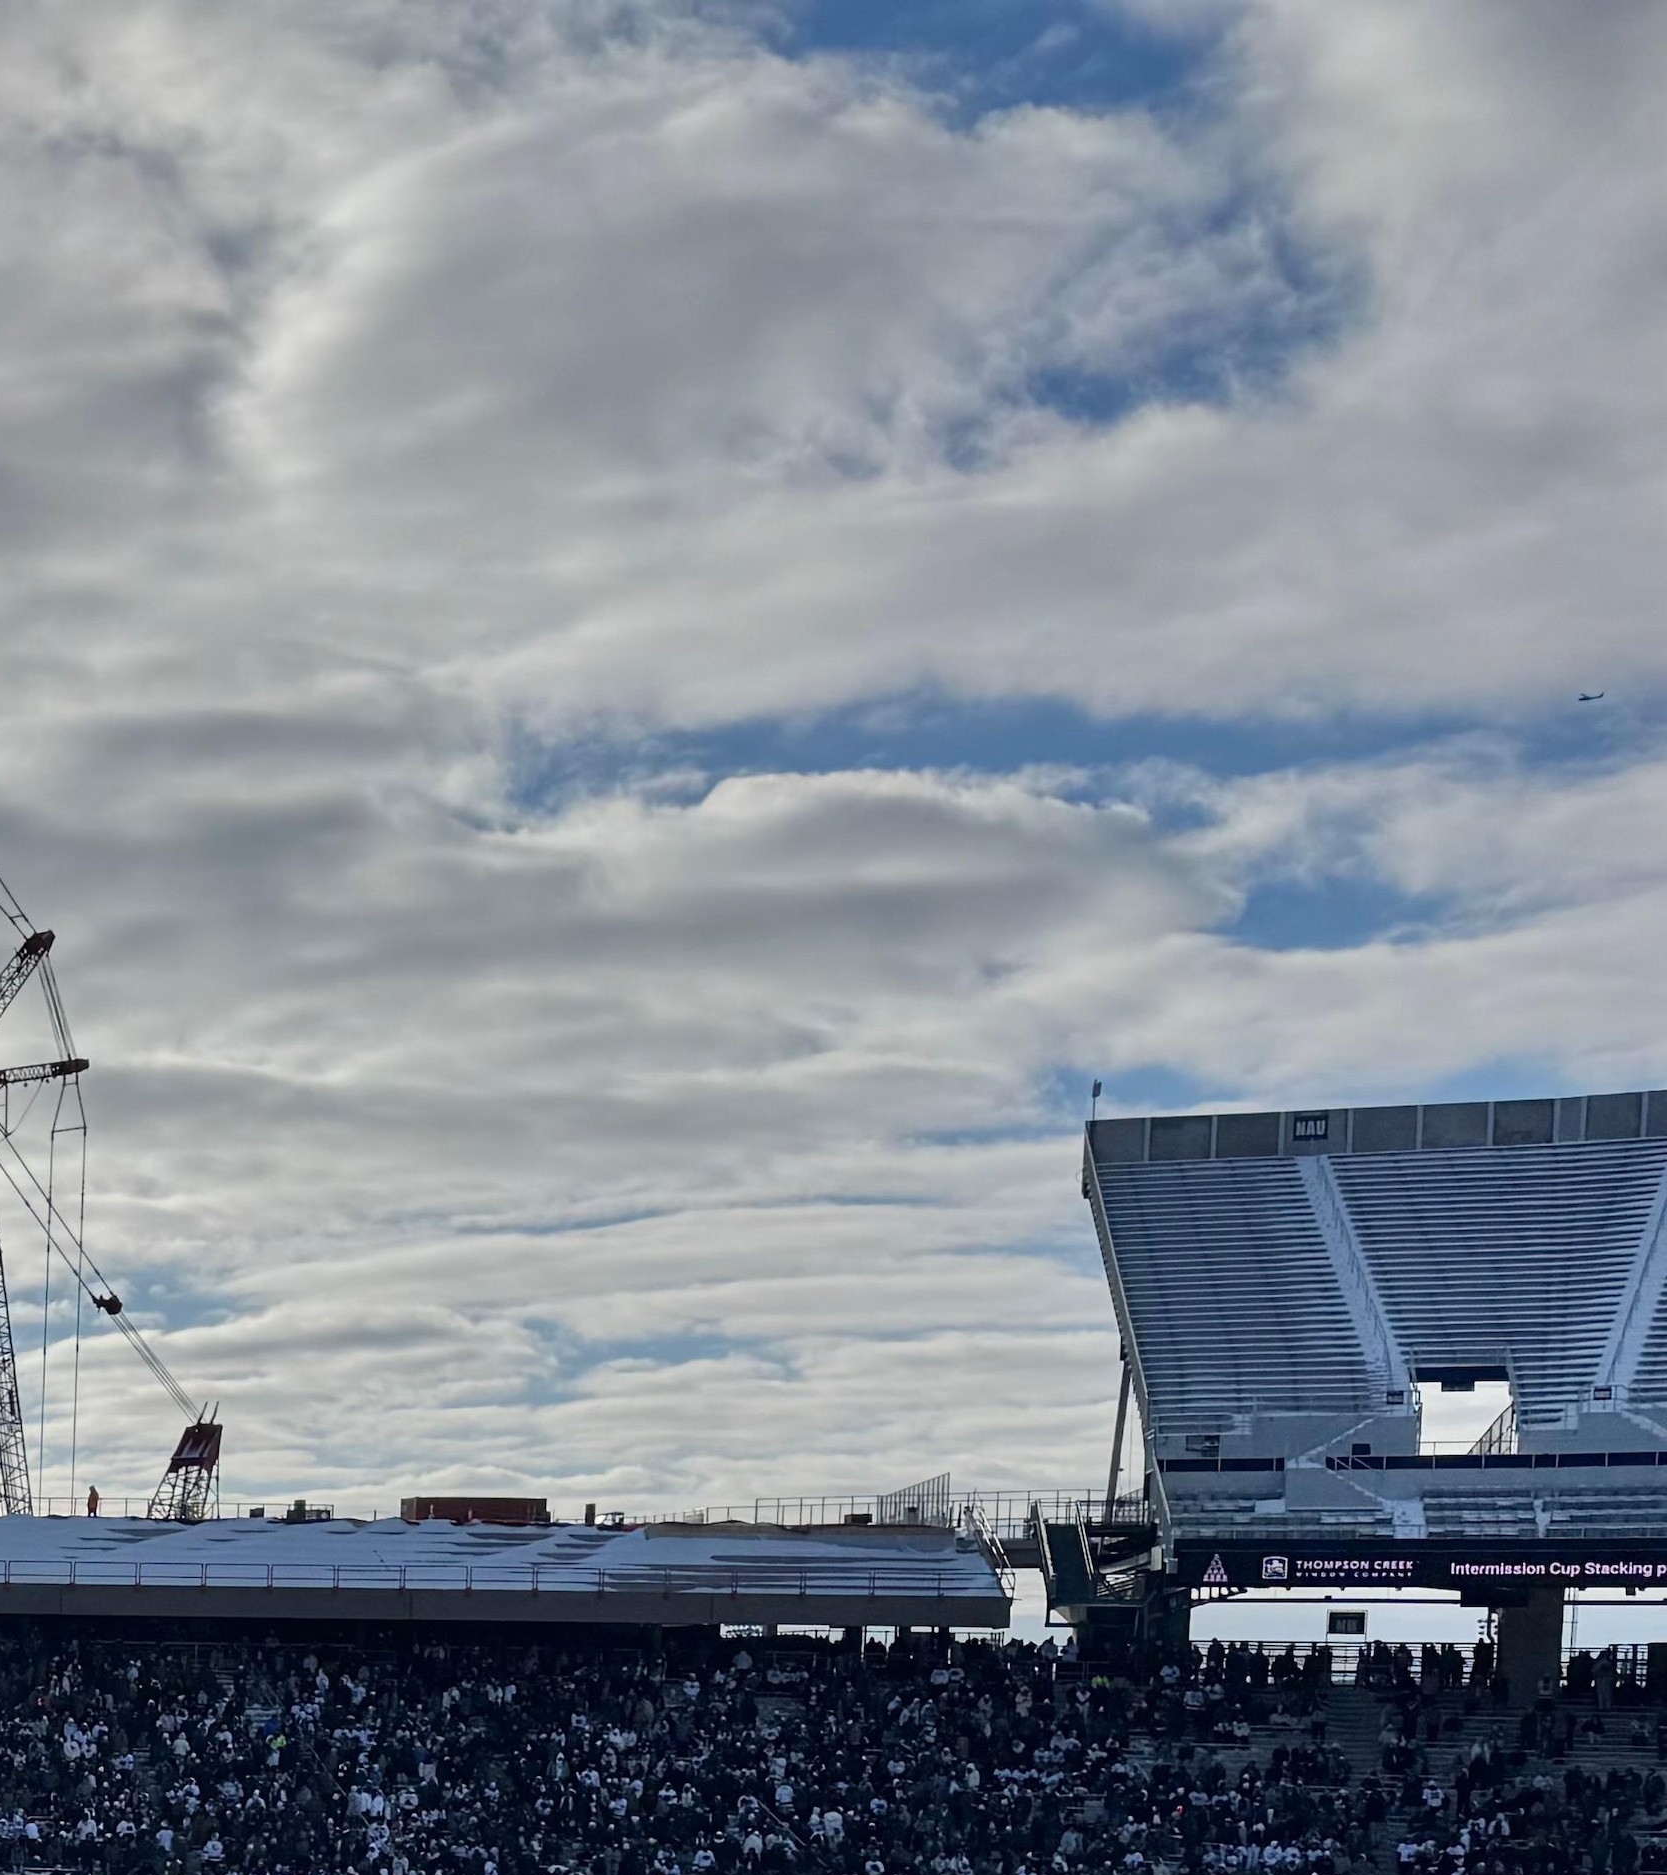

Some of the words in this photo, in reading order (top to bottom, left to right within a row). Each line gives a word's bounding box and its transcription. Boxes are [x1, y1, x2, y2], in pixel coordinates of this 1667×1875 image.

[1296, 1119, 1326, 1136] NAU
[1296, 1560, 1369, 1570] THOMPSON
[1374, 1560, 1413, 1570] CREEK
[1451, 1562, 1545, 1575] Intermission
[1549, 1562, 1581, 1577] Cup
[1584, 1561, 1653, 1577] Stacking
